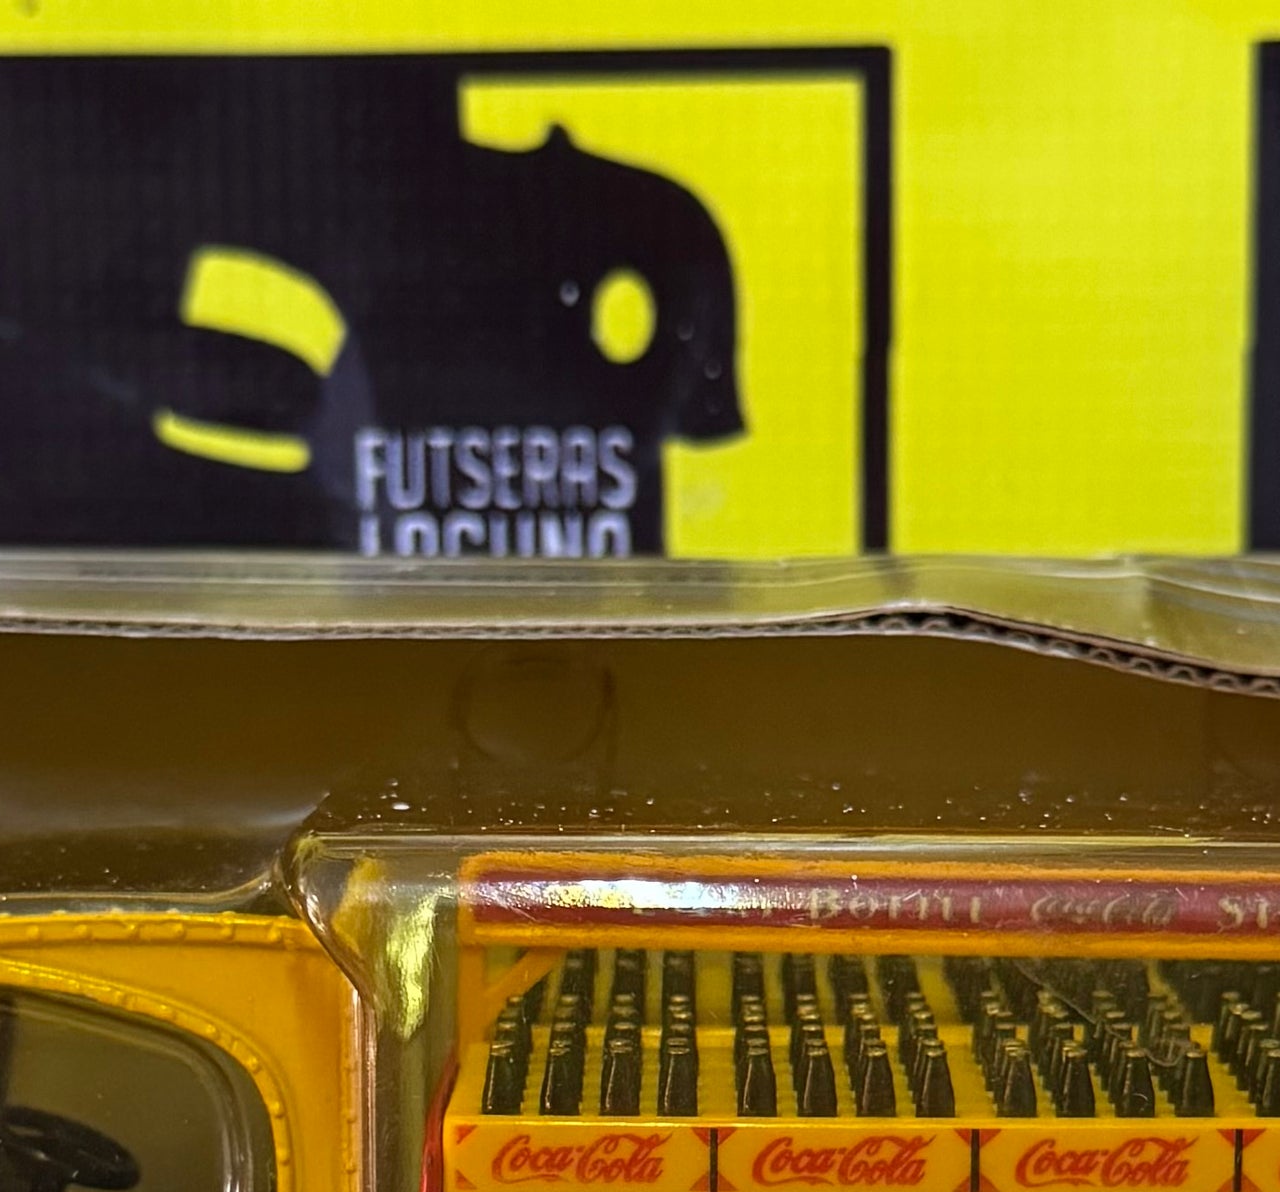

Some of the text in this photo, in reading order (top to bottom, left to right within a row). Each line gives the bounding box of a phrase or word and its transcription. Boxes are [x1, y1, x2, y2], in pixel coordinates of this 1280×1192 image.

[355, 426, 638, 510] FUTSERAS
[492, 1133, 672, 1184] Coca-Cola
[752, 1135, 935, 1186] Coca-Cola
[1015, 1136, 1200, 1188] Coca-Cola
